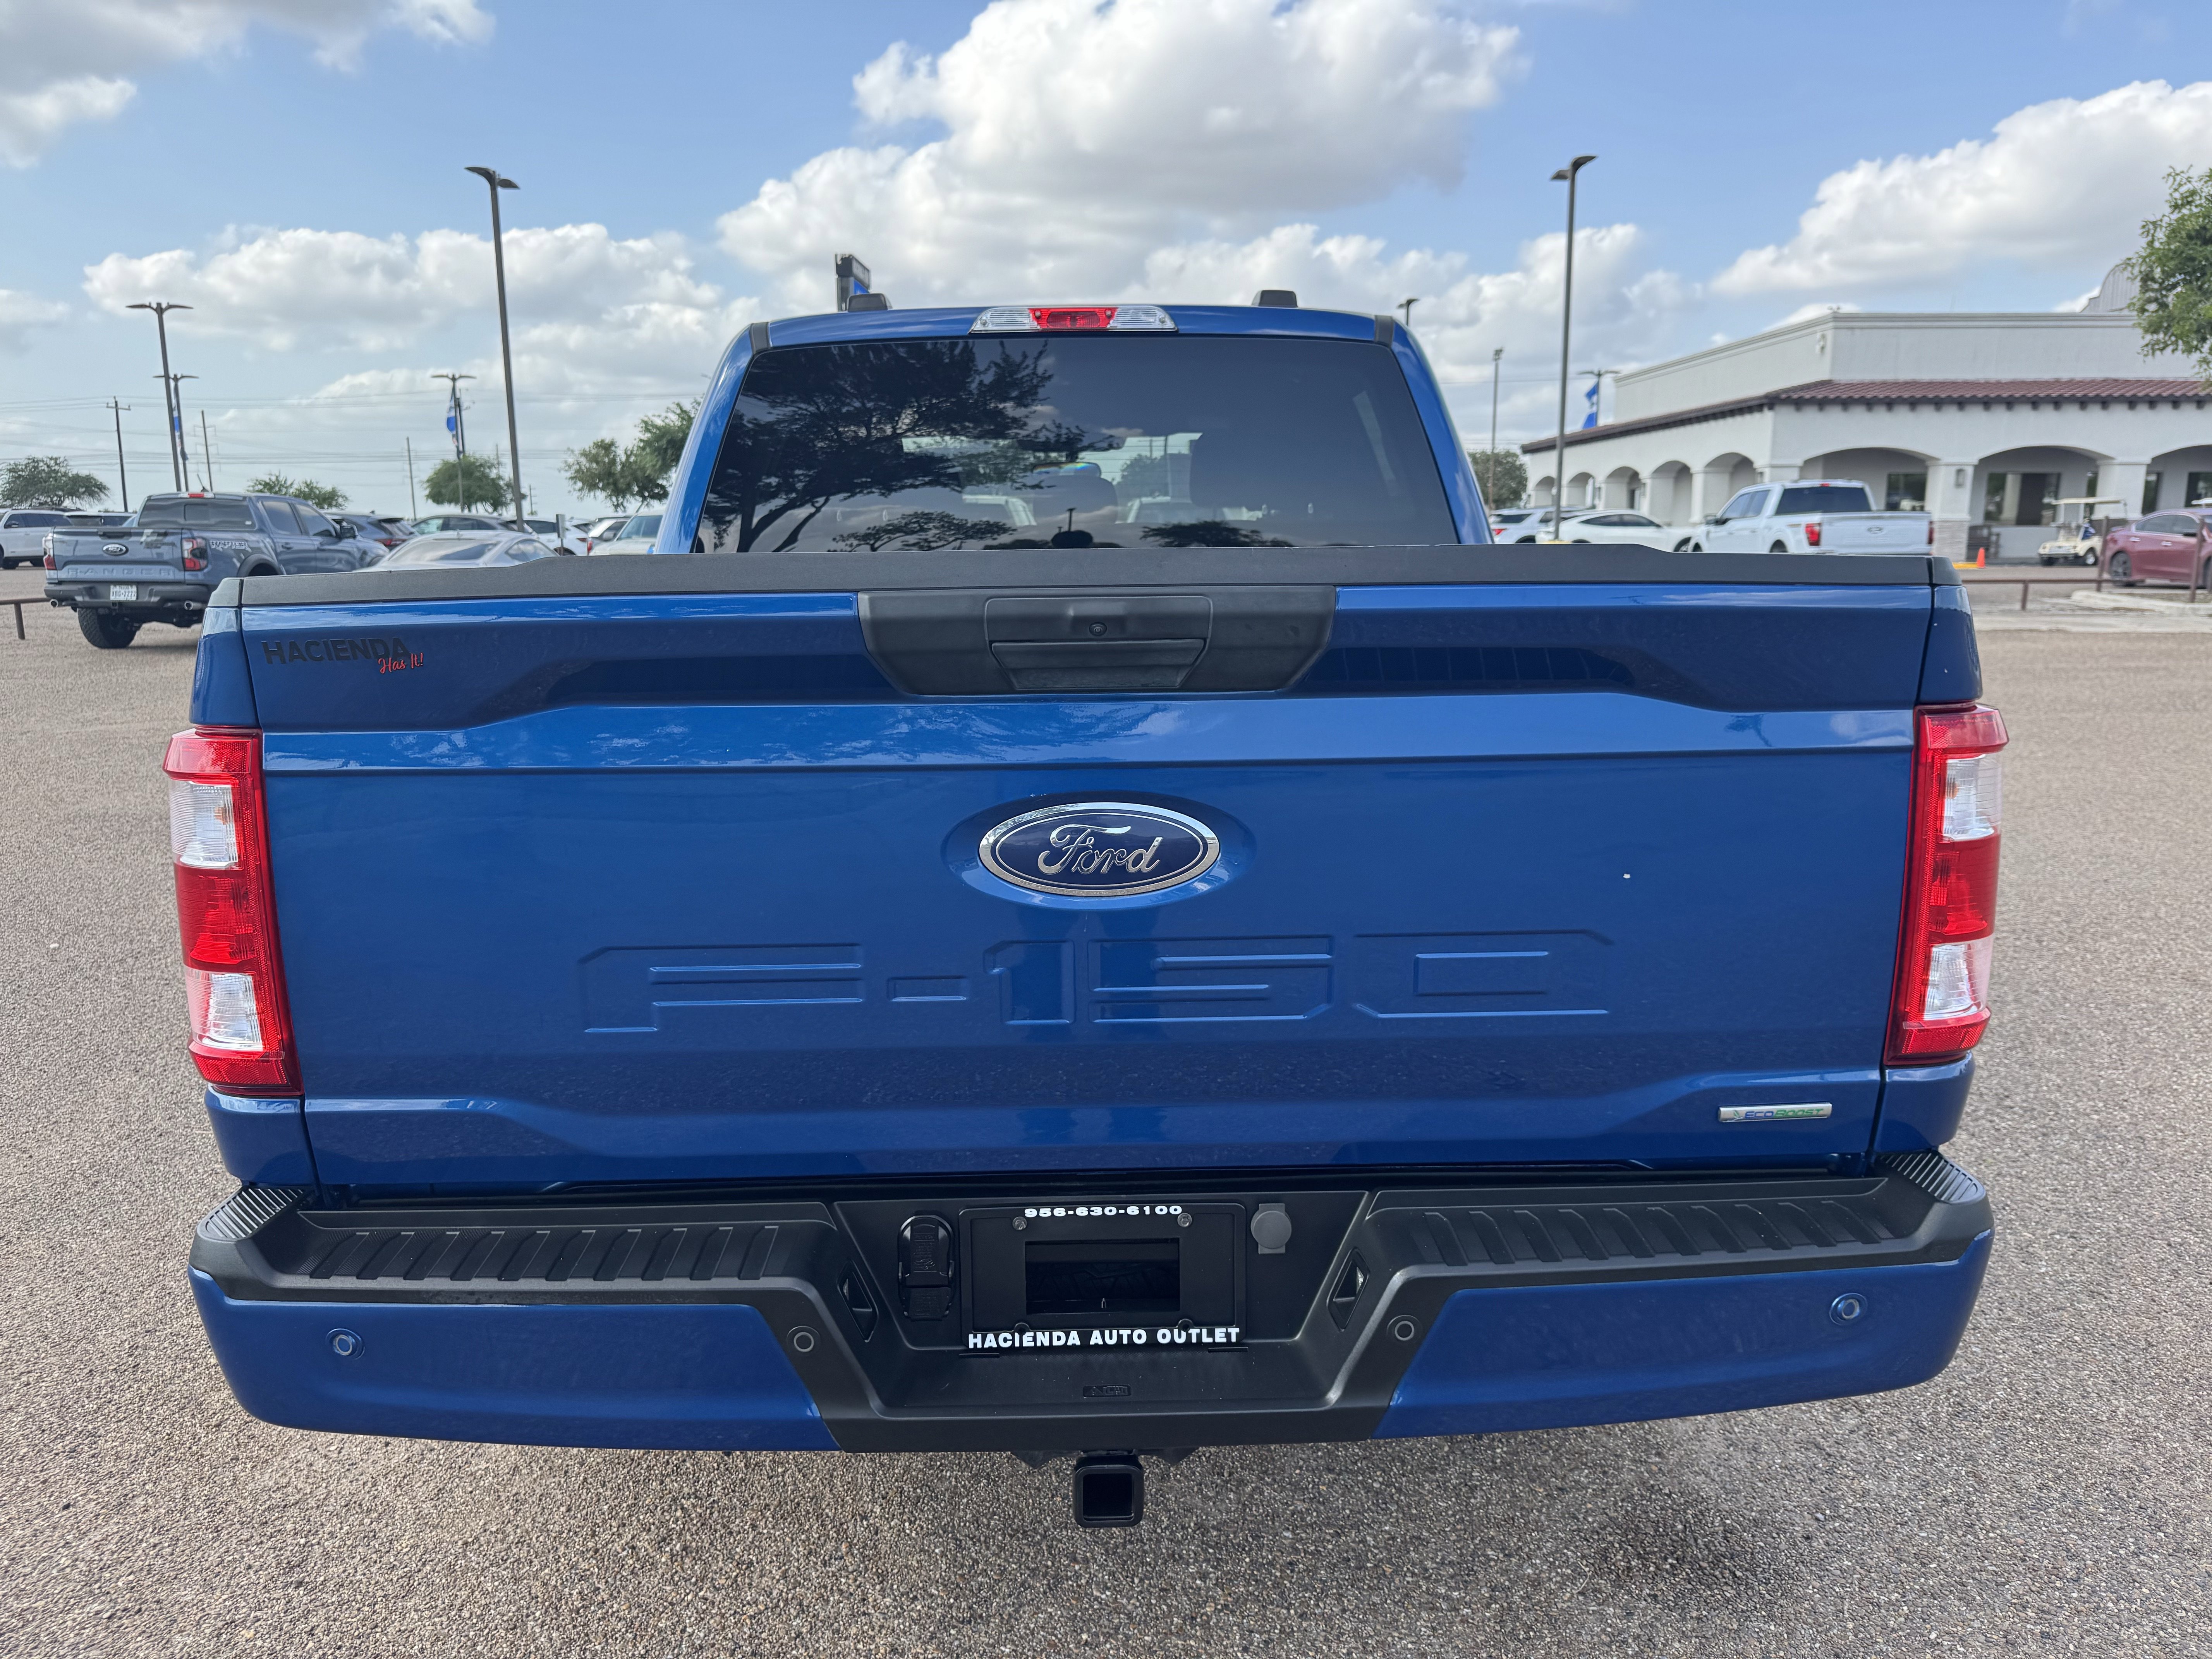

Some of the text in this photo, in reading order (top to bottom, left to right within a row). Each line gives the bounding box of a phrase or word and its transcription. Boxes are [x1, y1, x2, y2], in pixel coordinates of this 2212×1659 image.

[67, 567, 174, 578] RANGER
[261, 637, 412, 664] HACIENDA
[378, 653, 424, 674] Has It!
[1037, 824, 1161, 875] Ford
[577, 929, 1616, 1034] F-150
[1024, 1205, 1182, 1218] 956-630-6100
[968, 1328, 1240, 1348] HACIENDA AUTO OUTLET
